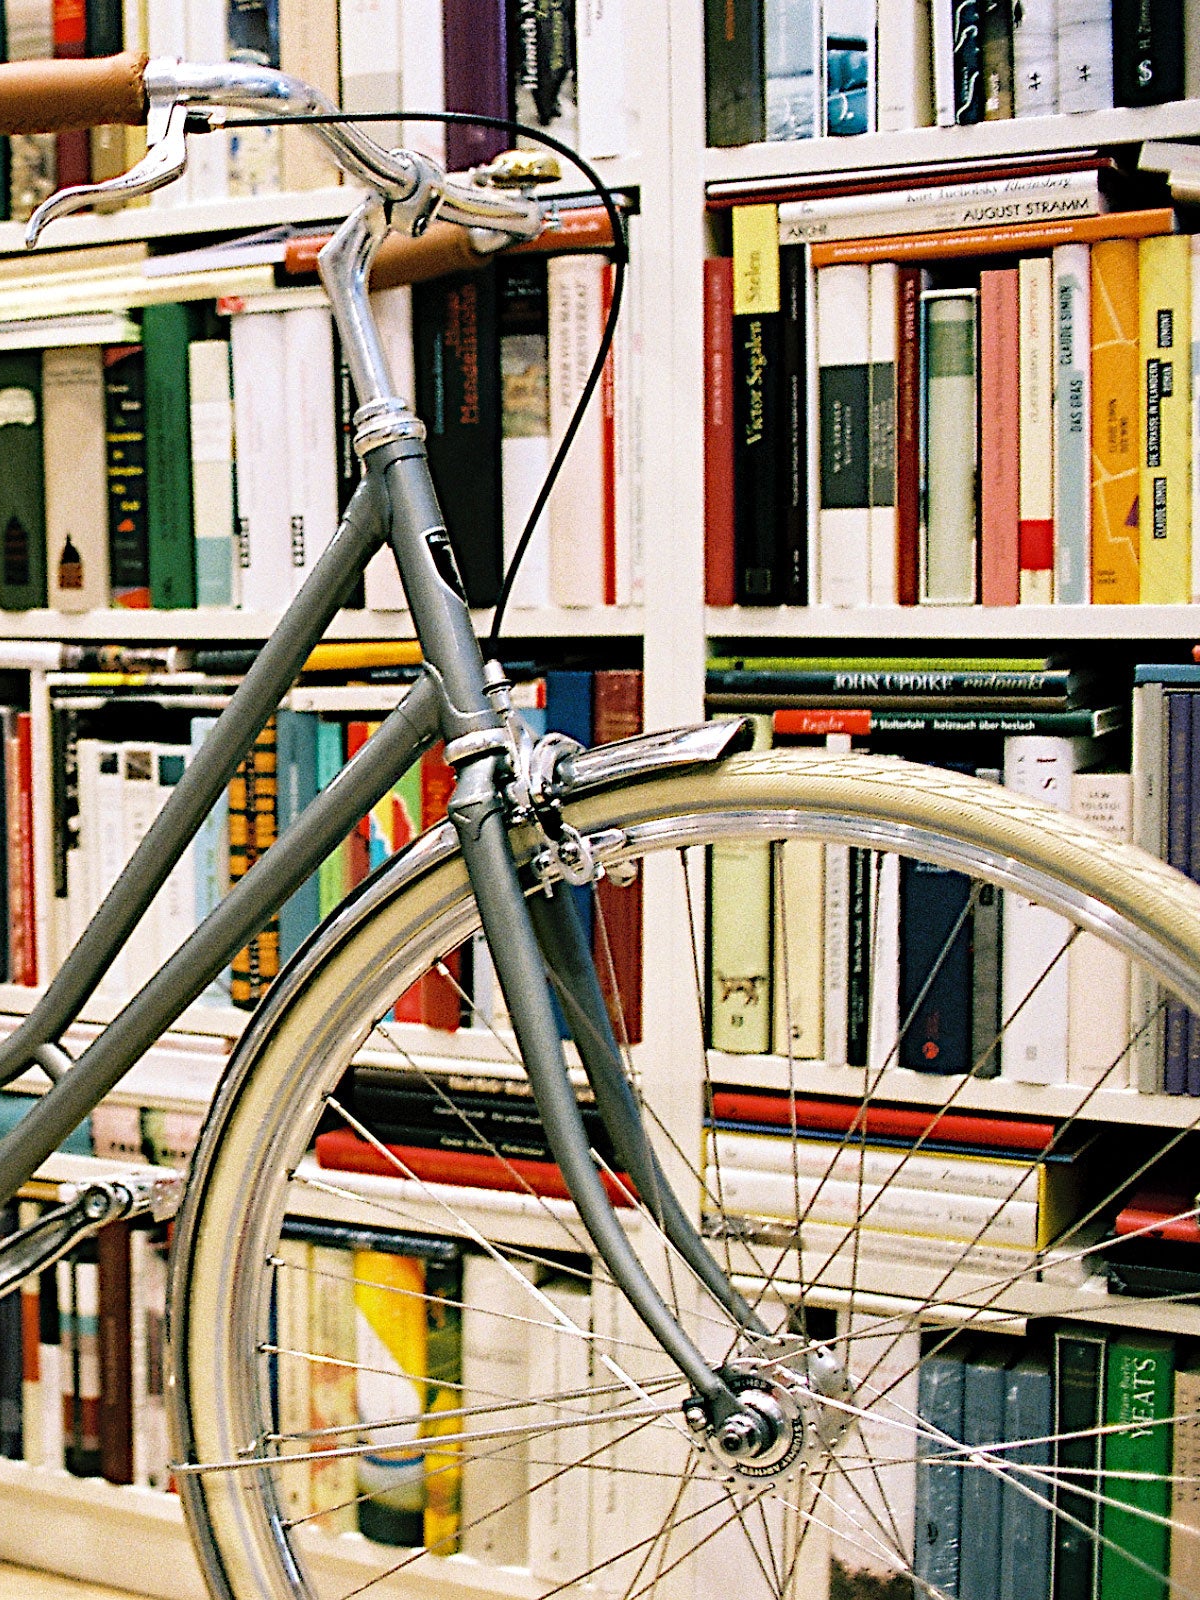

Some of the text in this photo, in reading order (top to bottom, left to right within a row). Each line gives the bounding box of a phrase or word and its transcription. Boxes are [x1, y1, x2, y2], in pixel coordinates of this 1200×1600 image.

[520, 18, 538, 90] Heinrich
[963, 203, 1020, 222] AUGUST
[1025, 198, 1089, 217] STRAMM
[745, 250, 762, 304] Stelen
[1059, 285, 1073, 366] CLAUDE SIMON
[1159, 313, 1172, 347] DUMONT
[744, 320, 767, 445] Victor Segalen
[1070, 379, 1083, 433] DAS GRAS
[1147, 362, 1159, 467] DIE STRASSE IN FLANDERN
[1153, 478, 1167, 538] CLAUDE SIMON
[833, 673, 1046, 692] JOHN UPDIKE endpunkt
[933, 719, 977, 731] holzrauch
[979, 719, 999, 731] über
[1001, 719, 1036, 731] heslach
[1130, 1357, 1157, 1438] YEATS
